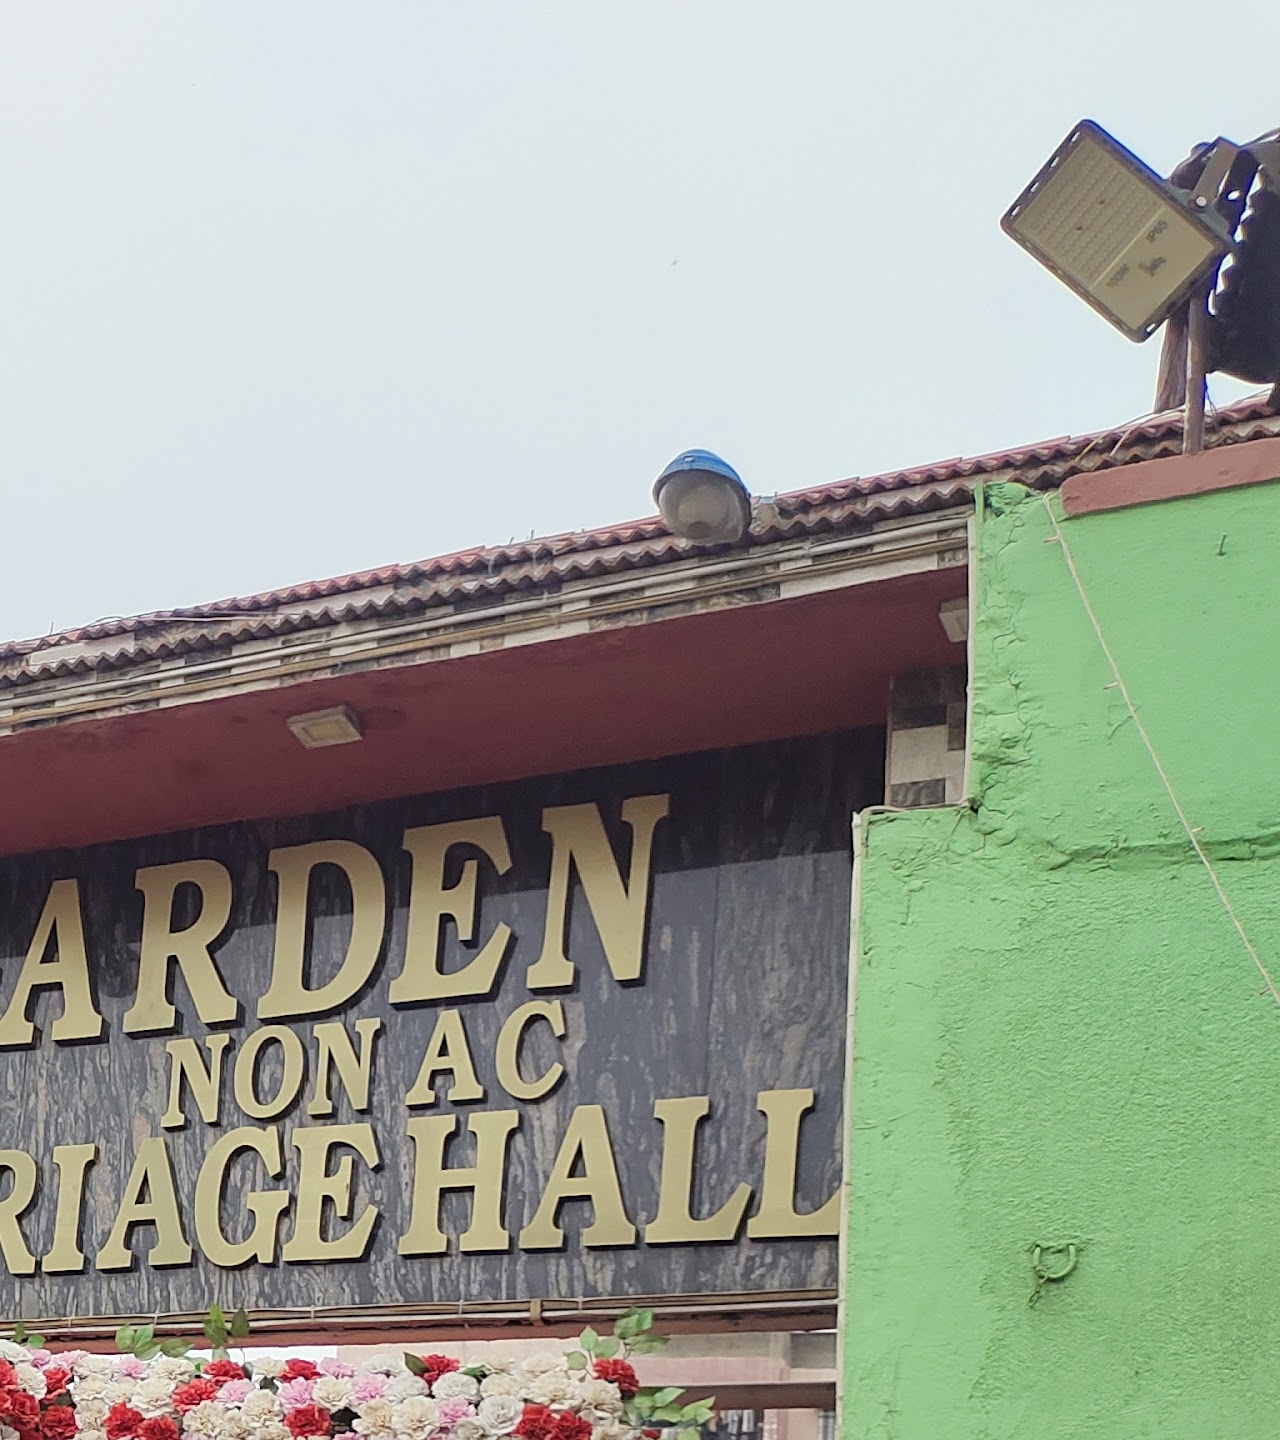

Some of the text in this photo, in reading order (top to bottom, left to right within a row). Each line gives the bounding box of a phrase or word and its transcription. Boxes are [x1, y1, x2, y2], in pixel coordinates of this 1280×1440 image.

[162, 1001, 566, 1129] NON AC
[398, 1088, 842, 1256] HALL
